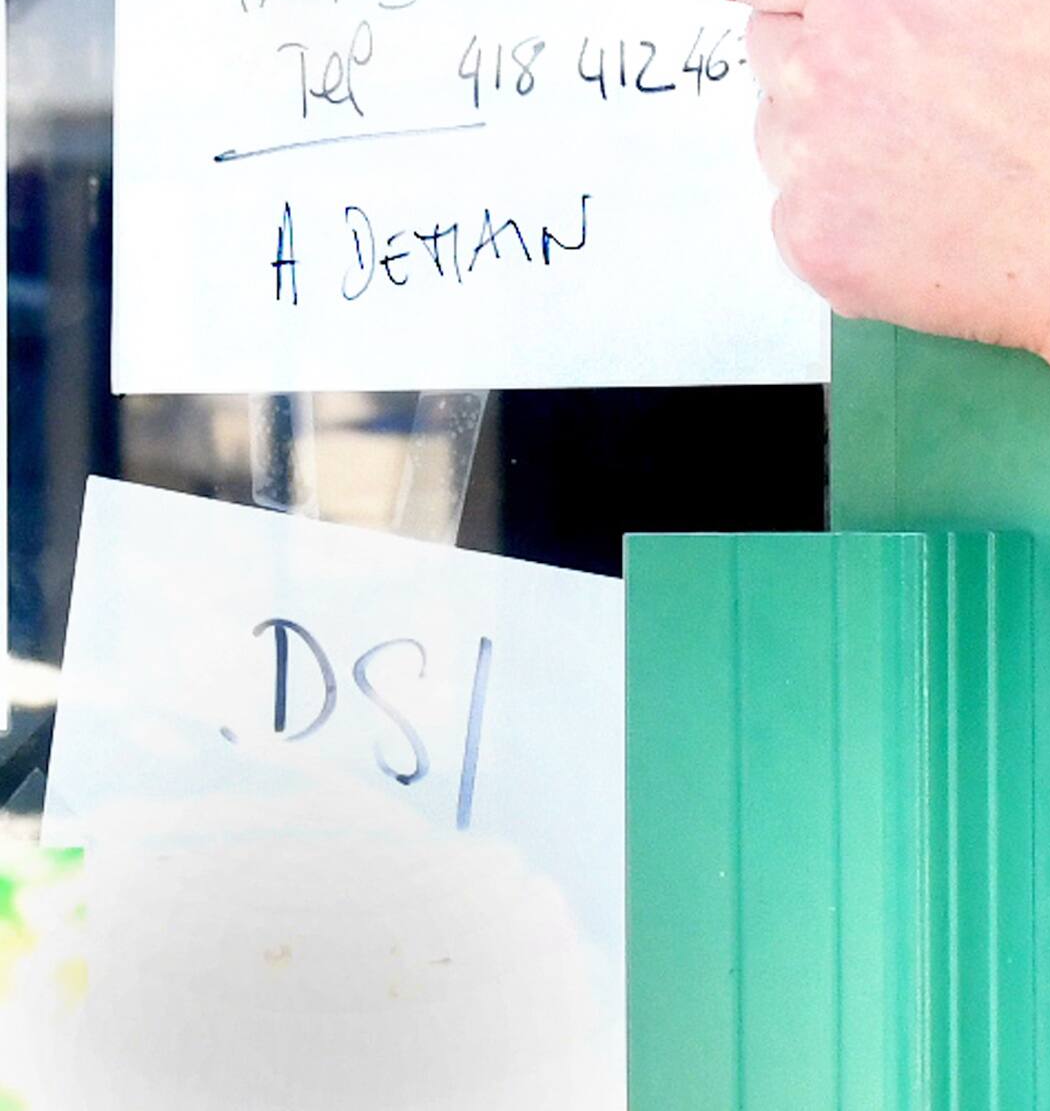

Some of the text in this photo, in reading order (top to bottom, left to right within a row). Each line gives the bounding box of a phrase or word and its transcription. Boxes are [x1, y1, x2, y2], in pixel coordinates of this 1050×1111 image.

[456, 34, 547, 110] 418
[577, 37, 678, 101] 412
[681, 26, 747, 98] 46
[270, 193, 593, 306] A DEMAIN
